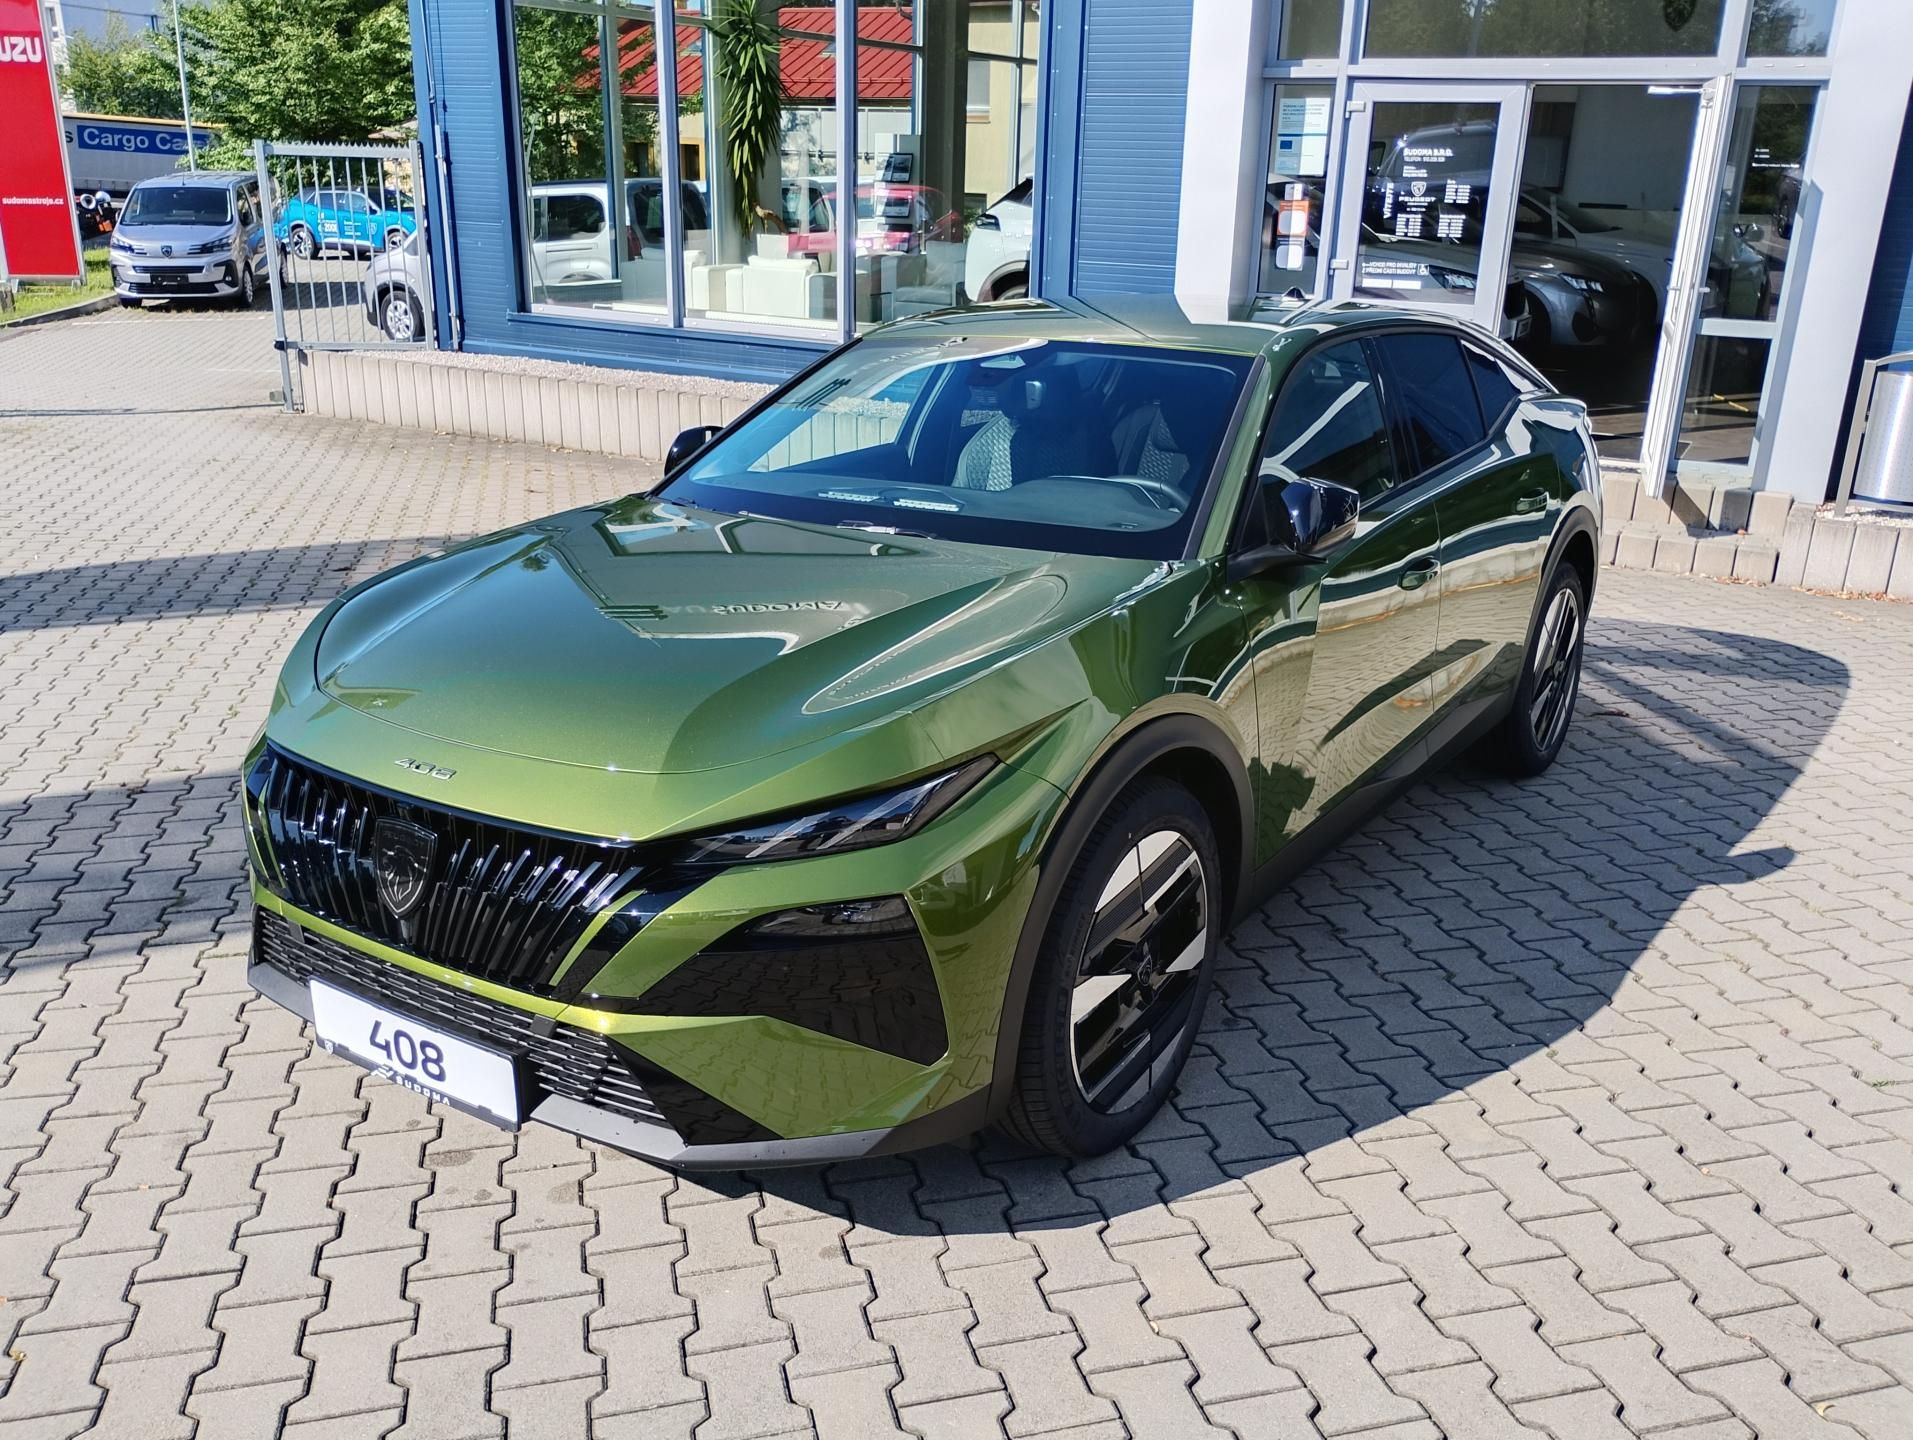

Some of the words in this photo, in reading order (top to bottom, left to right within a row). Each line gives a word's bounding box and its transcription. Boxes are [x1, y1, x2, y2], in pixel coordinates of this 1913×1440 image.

[83, 128, 149, 151] Cargo
[394, 758, 457, 780] 408
[369, 1020, 447, 1082] 408
